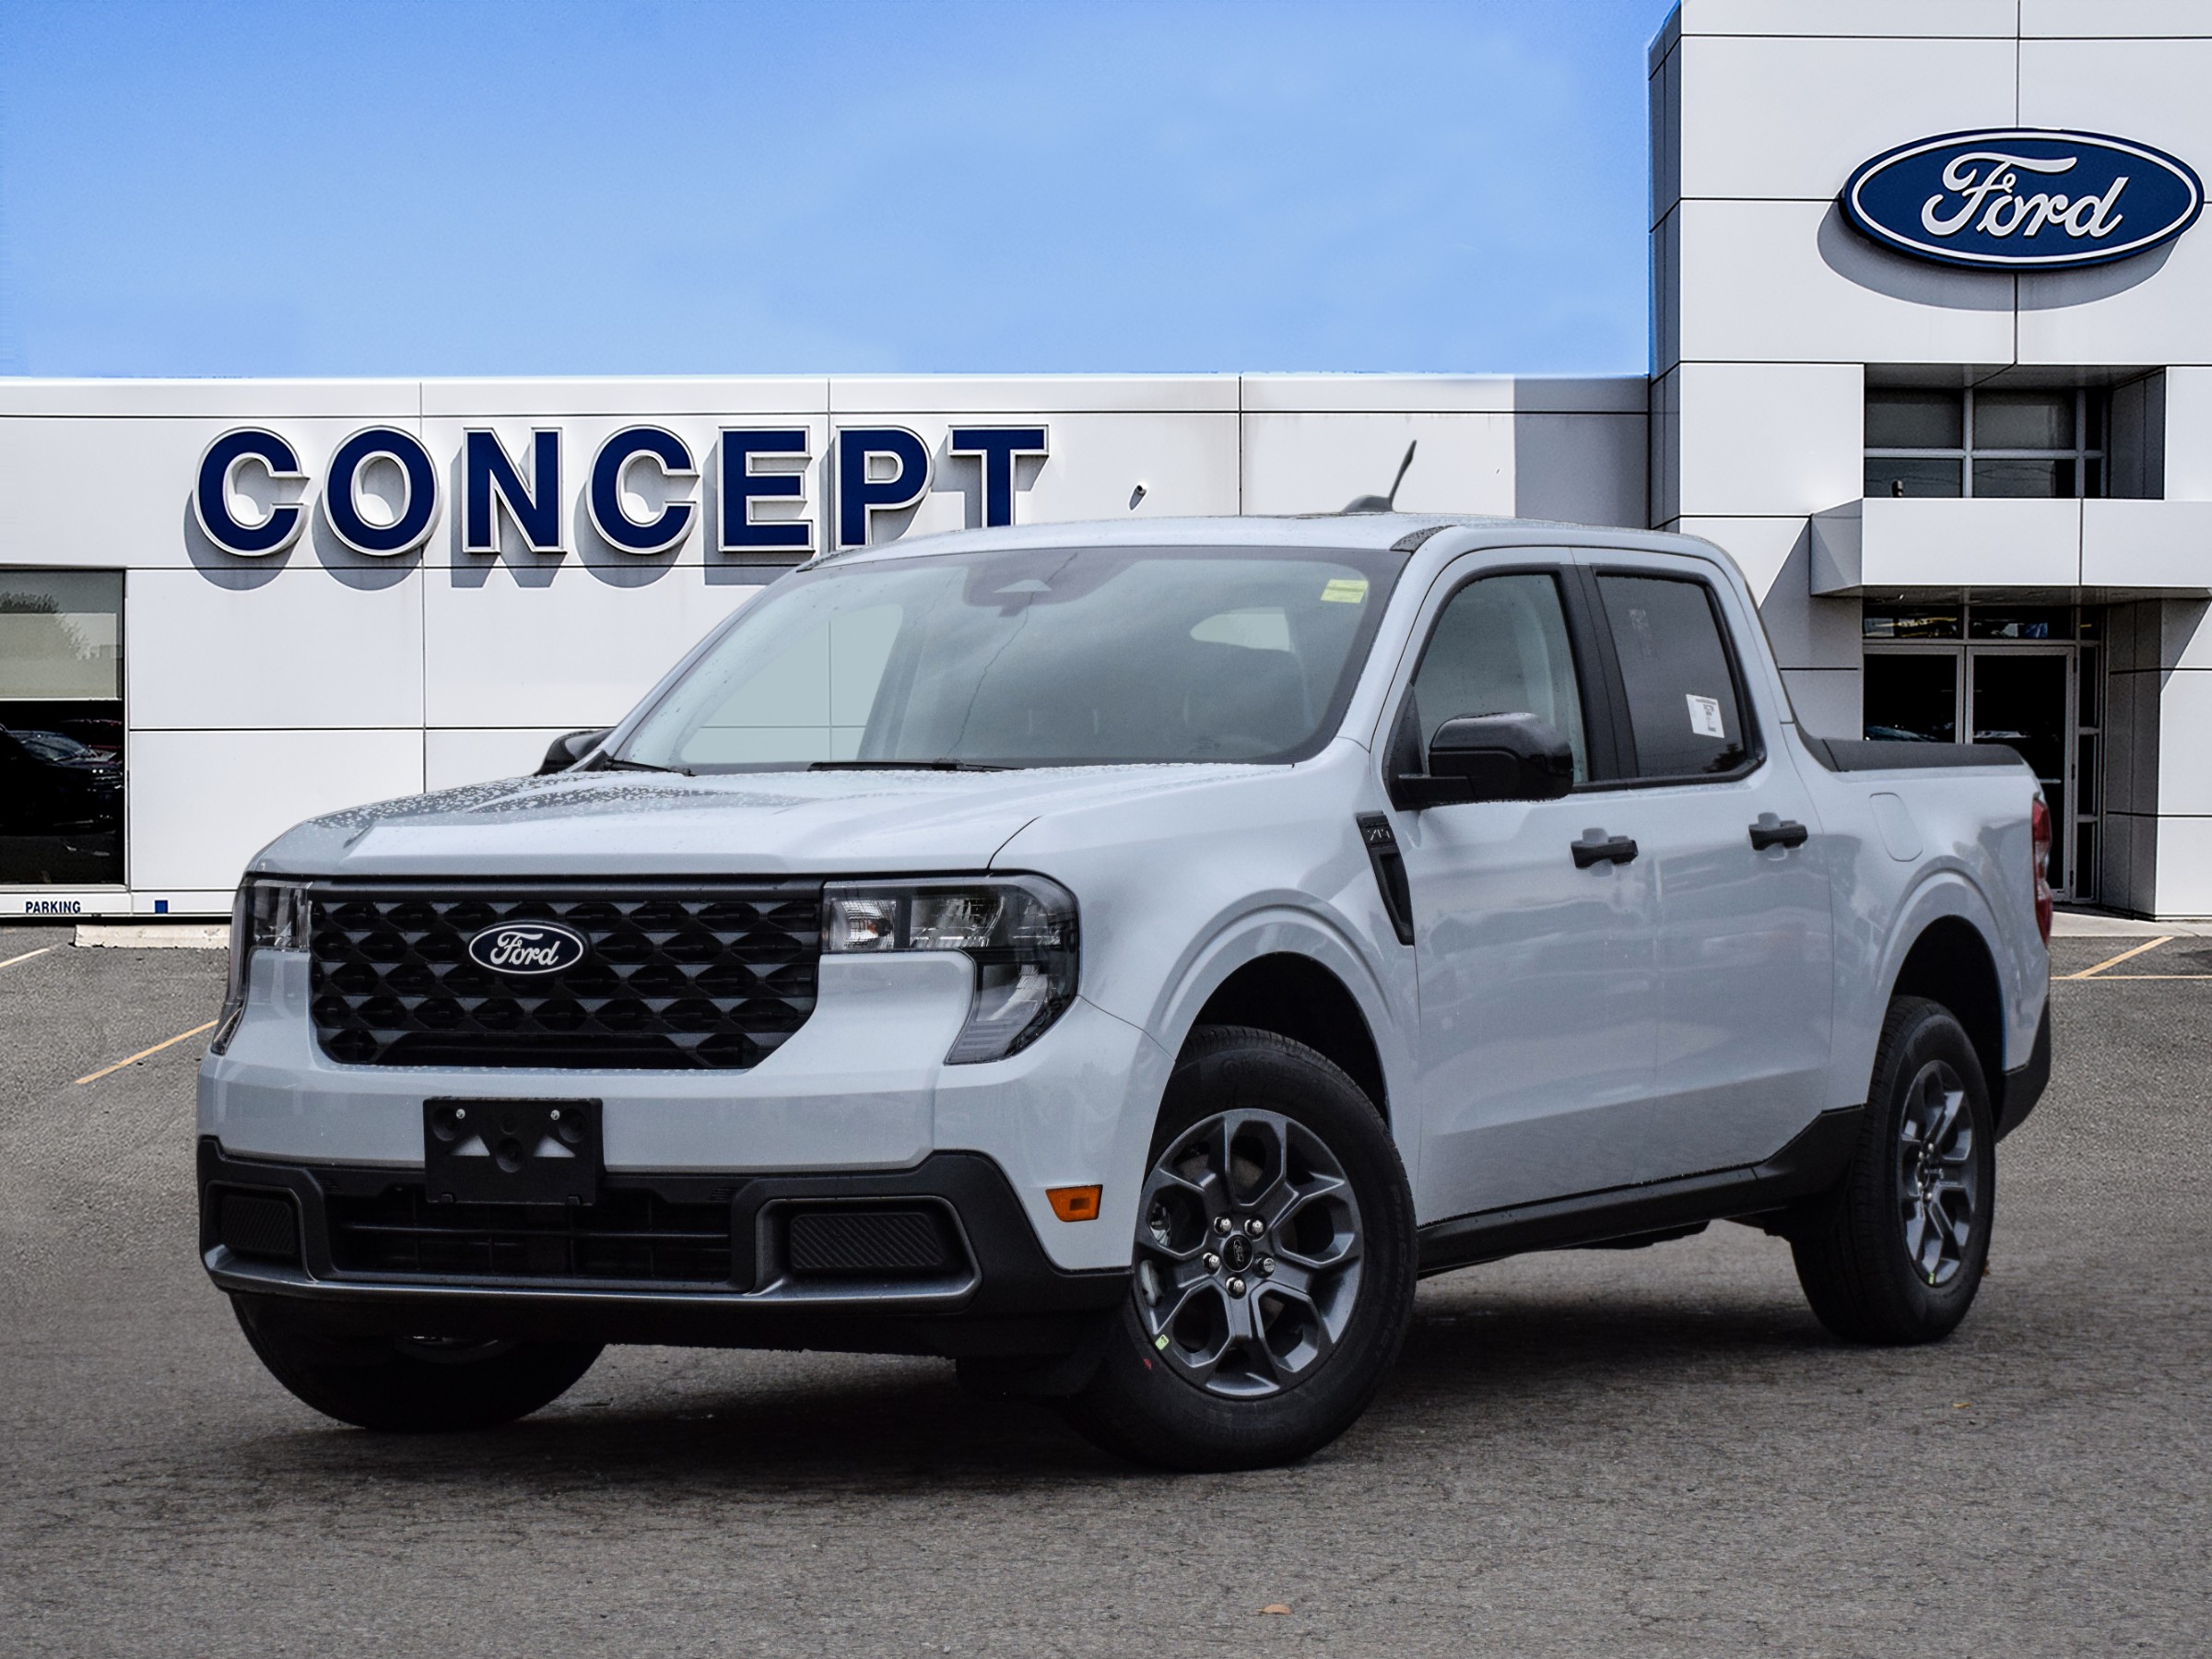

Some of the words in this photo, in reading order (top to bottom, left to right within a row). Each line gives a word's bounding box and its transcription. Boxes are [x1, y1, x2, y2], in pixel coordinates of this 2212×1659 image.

[1921, 151, 2129, 238] Ford
[192, 424, 1049, 557] CONCEPT
[25, 900, 81, 914] PARKING
[489, 931, 560, 965] Ford
